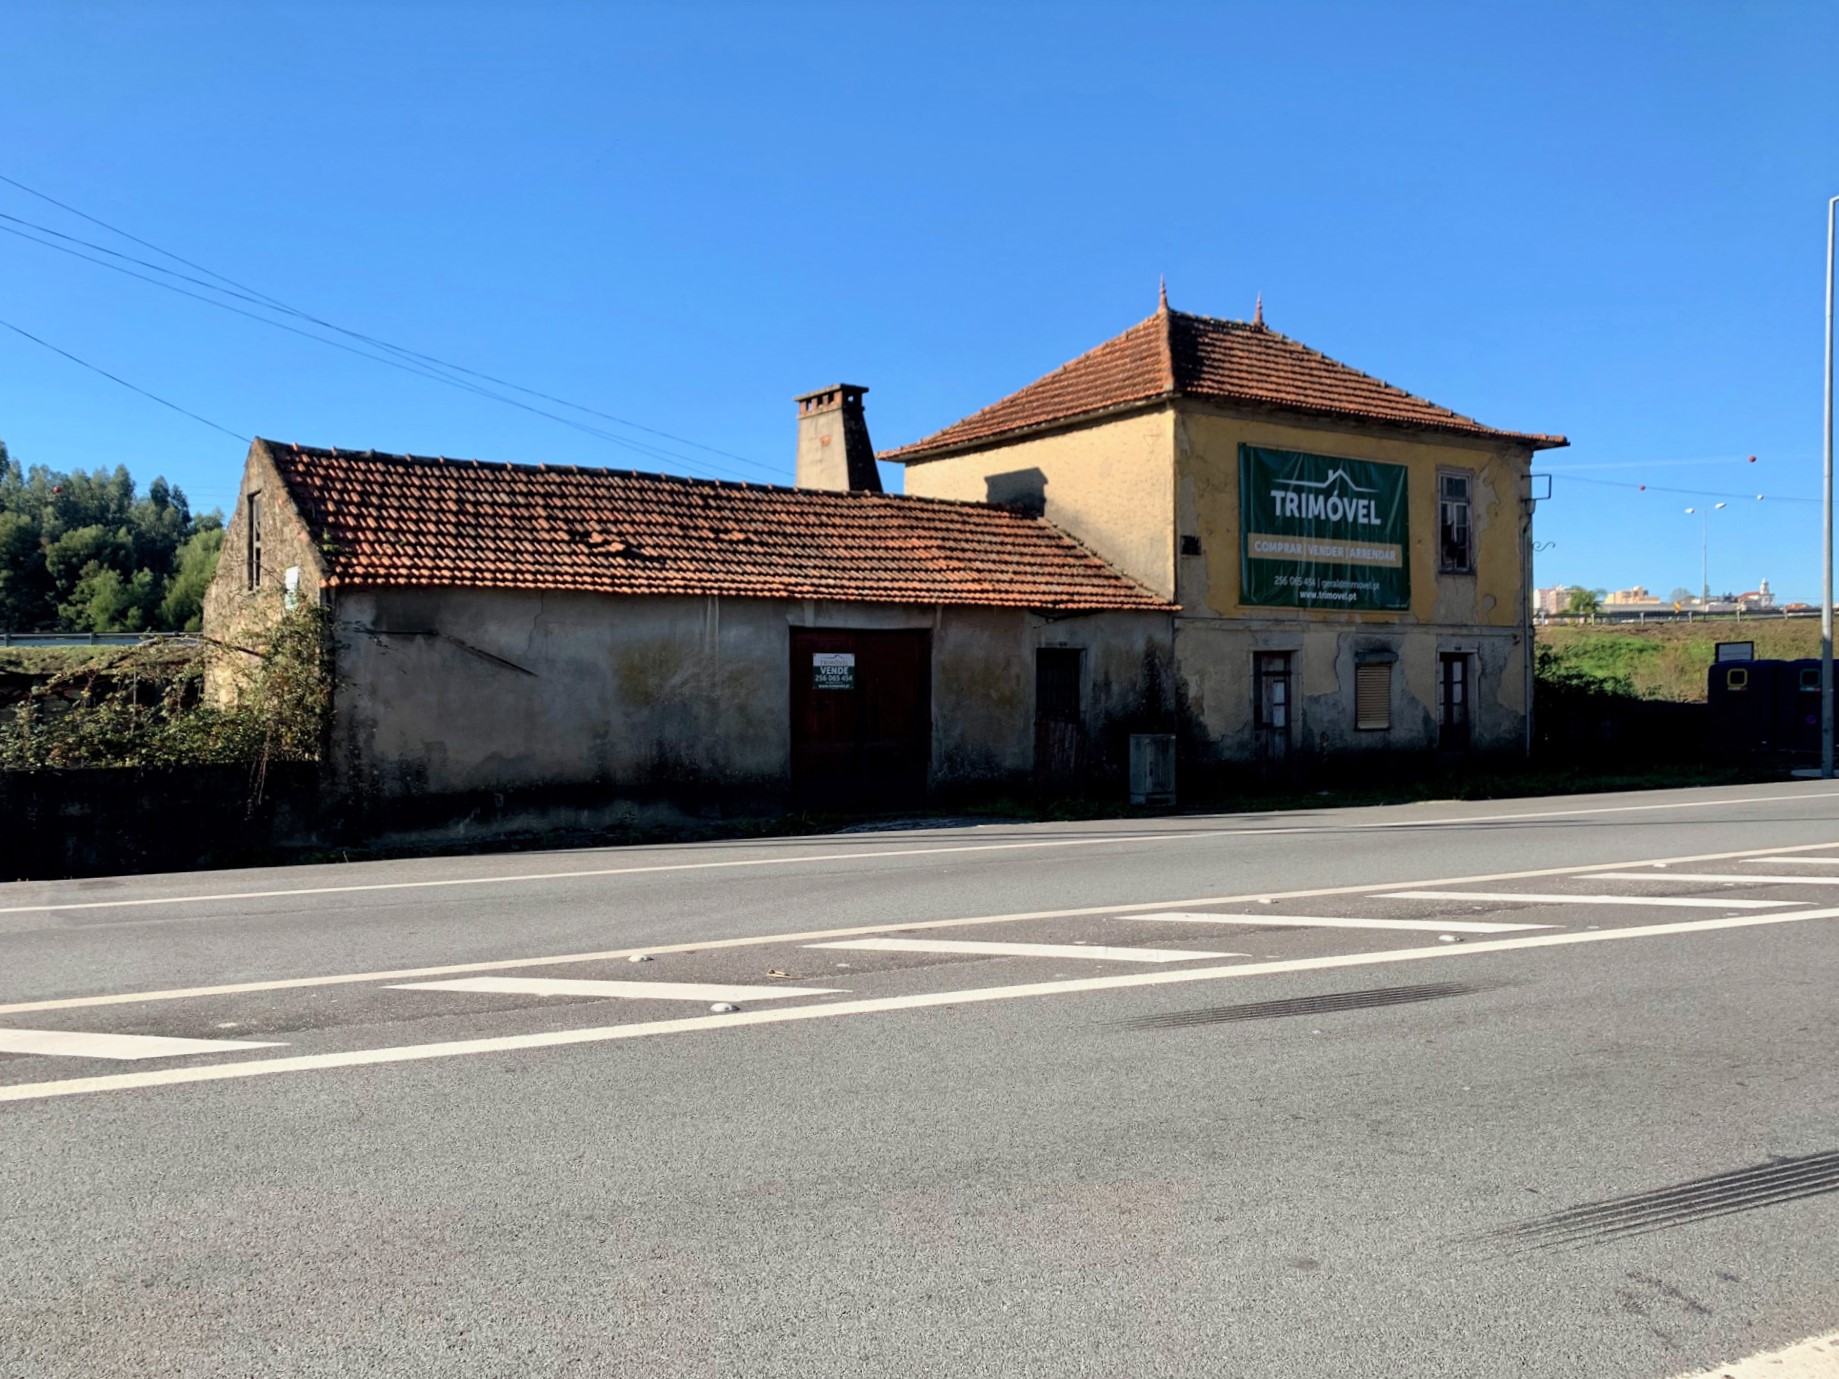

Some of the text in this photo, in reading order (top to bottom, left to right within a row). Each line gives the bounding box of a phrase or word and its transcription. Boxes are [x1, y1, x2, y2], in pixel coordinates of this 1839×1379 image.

[1270, 490, 1381, 525] TRIMÓVEL
[1254, 540, 1396, 561] COMPRAR VENDER ARRENDAR
[1274, 575, 1288, 586] 256
[1299, 590, 1357, 602] www.trimovel.pt
[820, 666, 849, 675] VENDE
